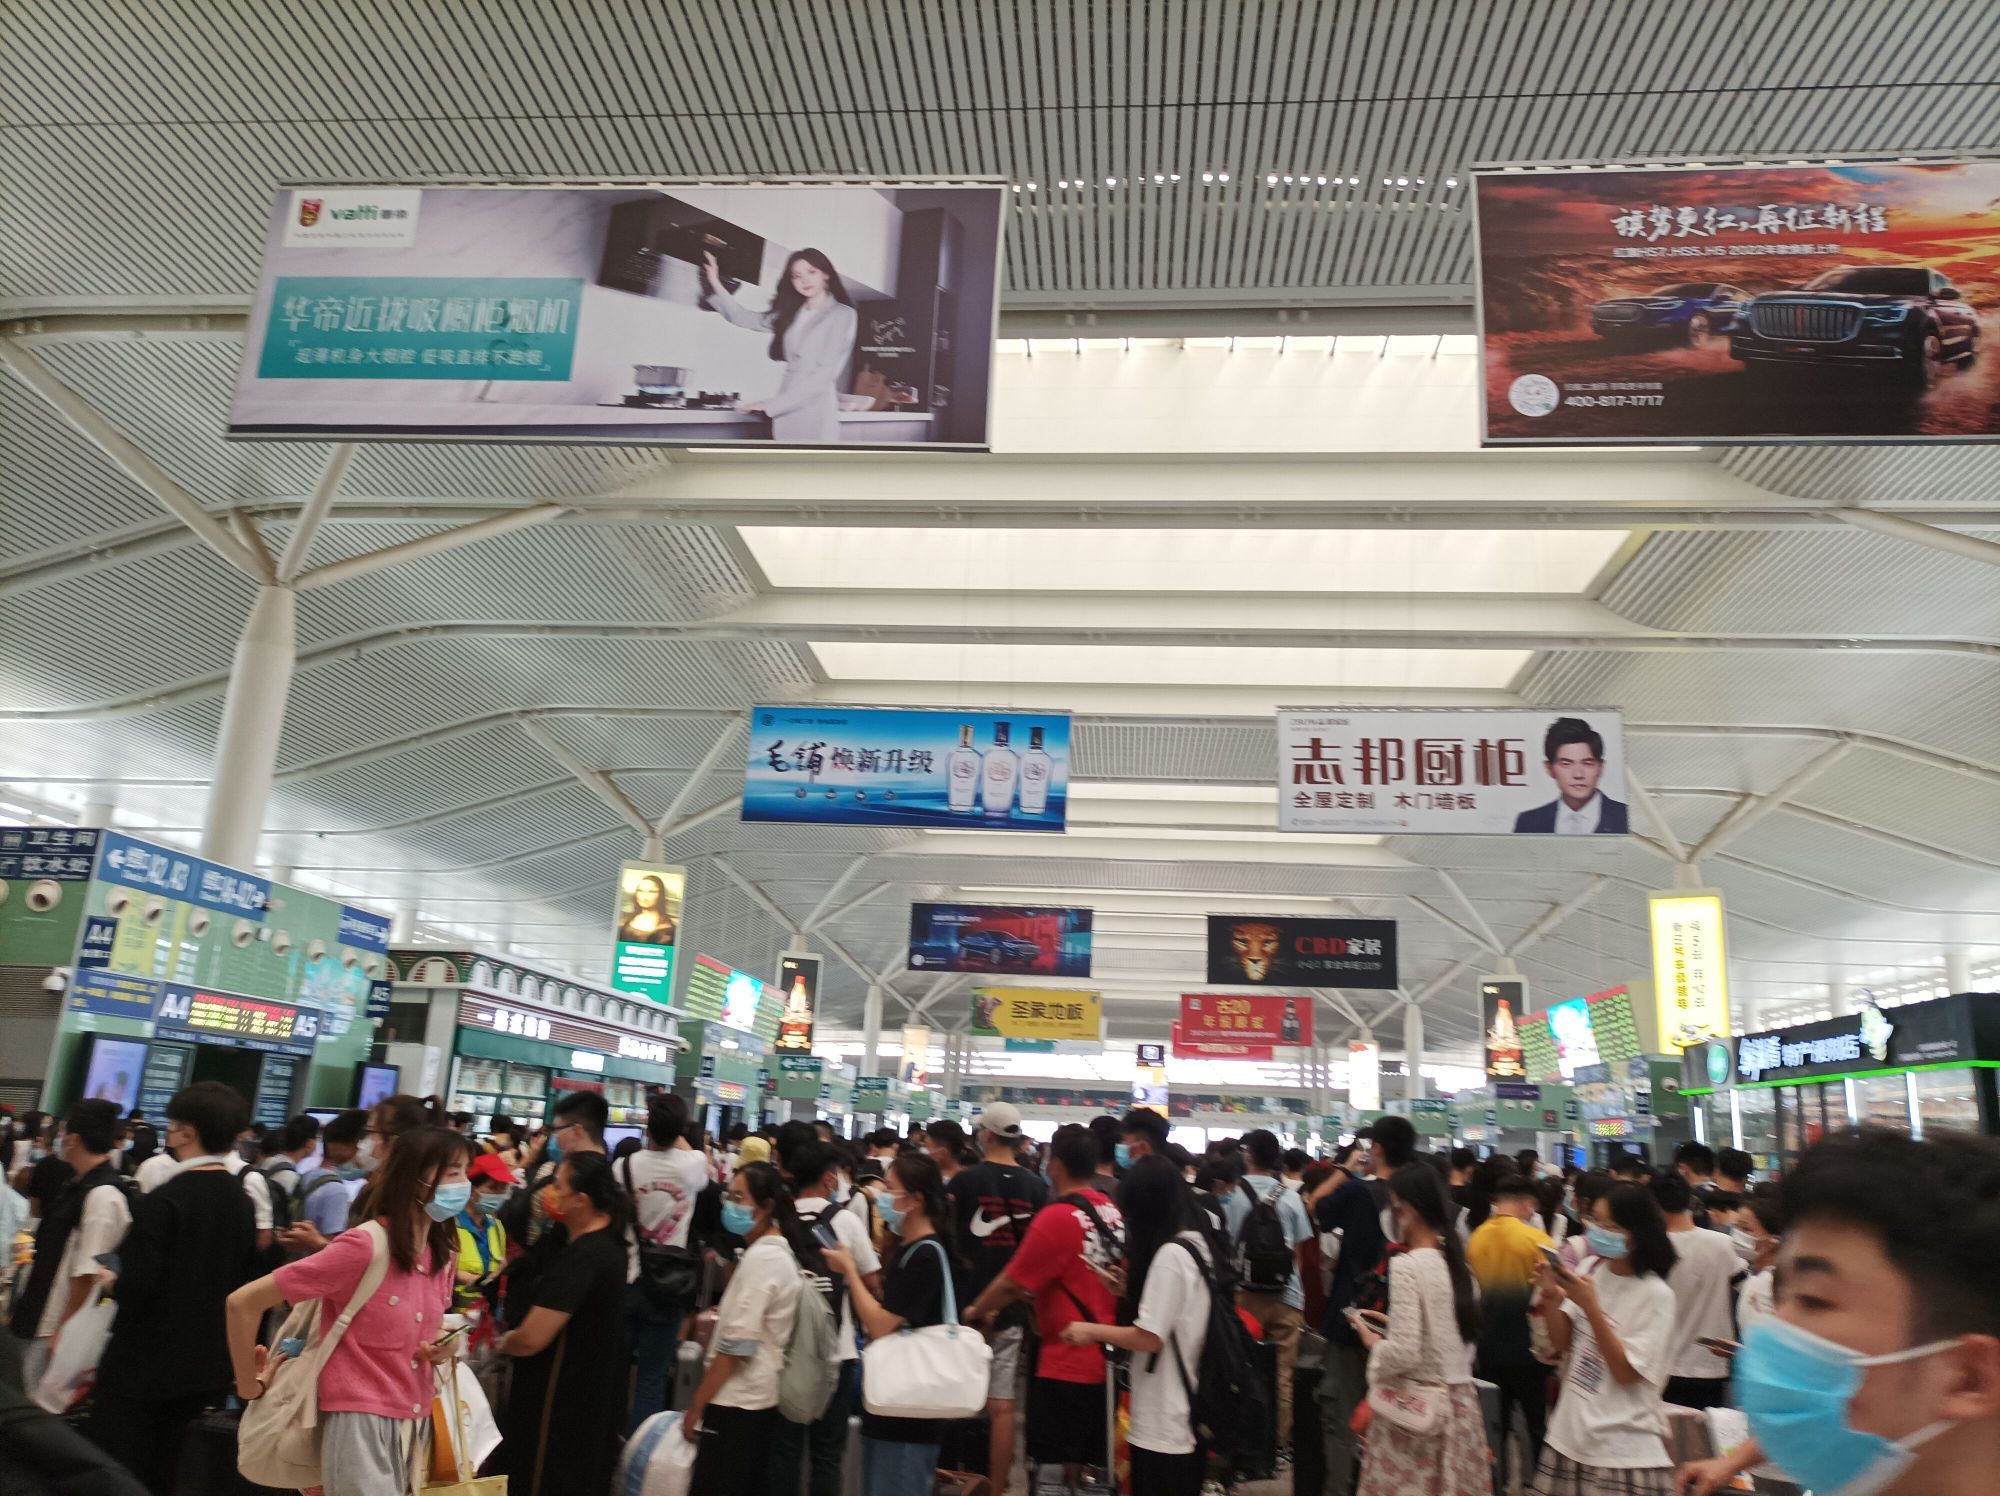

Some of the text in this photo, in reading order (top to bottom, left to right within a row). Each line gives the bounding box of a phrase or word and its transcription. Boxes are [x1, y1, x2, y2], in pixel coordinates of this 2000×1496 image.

[1290, 737, 1528, 786] 志邦厨柜
[1293, 791, 1478, 811] 全屋定制 木门墙板
[84, 924, 114, 945] A4
[158, 993, 193, 1019] A4
[292, 1014, 318, 1038] A5
